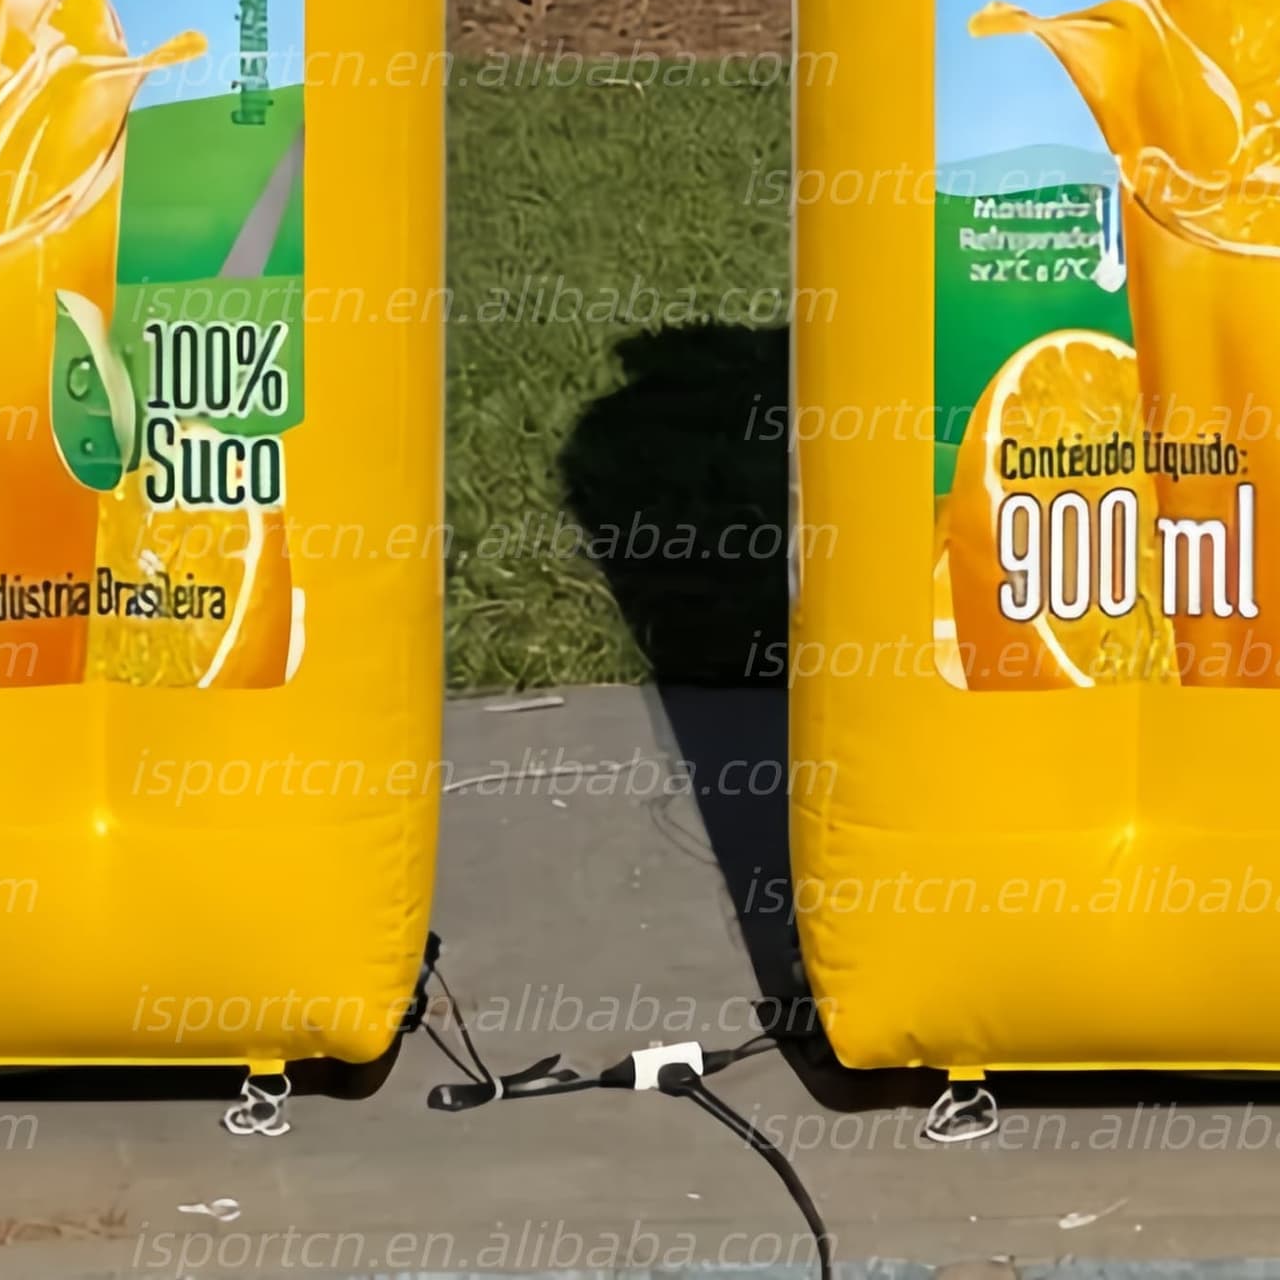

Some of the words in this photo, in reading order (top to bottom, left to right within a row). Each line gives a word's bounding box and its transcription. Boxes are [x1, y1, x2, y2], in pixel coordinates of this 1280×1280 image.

[145, 323, 283, 413] 100%
[145, 416, 281, 505] Suco
[998, 487, 1139, 623] 900
[1157, 481, 1260, 619] ml
